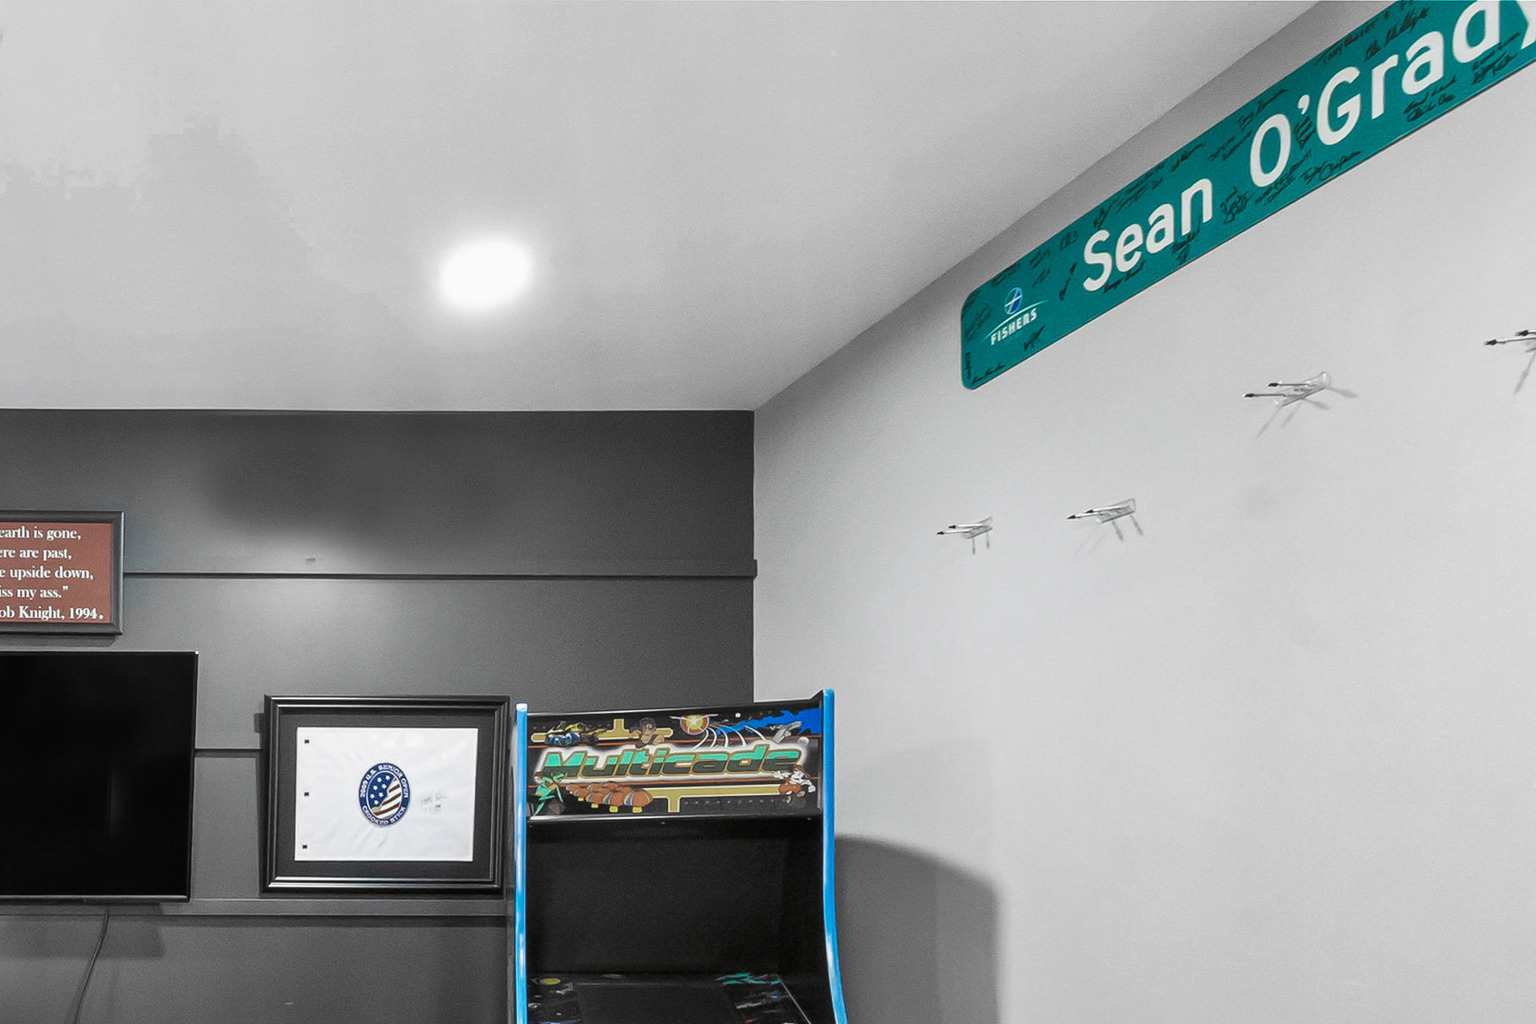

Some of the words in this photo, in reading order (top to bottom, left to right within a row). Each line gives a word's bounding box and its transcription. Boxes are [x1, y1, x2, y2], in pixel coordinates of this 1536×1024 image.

[1083, 178, 1213, 292] Sean
[990, 308, 1038, 346] FISHERS
[33, 525, 44, 539] is
[46, 529, 82, 541] gone,
[19, 549, 39, 559] are
[43, 547, 73, 562] past,
[9, 565, 51, 580] upside
[54, 565, 94, 580] down,
[16, 588, 37, 601] my
[39, 585, 69, 598] ass.”
[18, 605, 65, 621] Knight,
[69, 607, 104, 620] 1994.
[541, 743, 802, 779] Multicade
